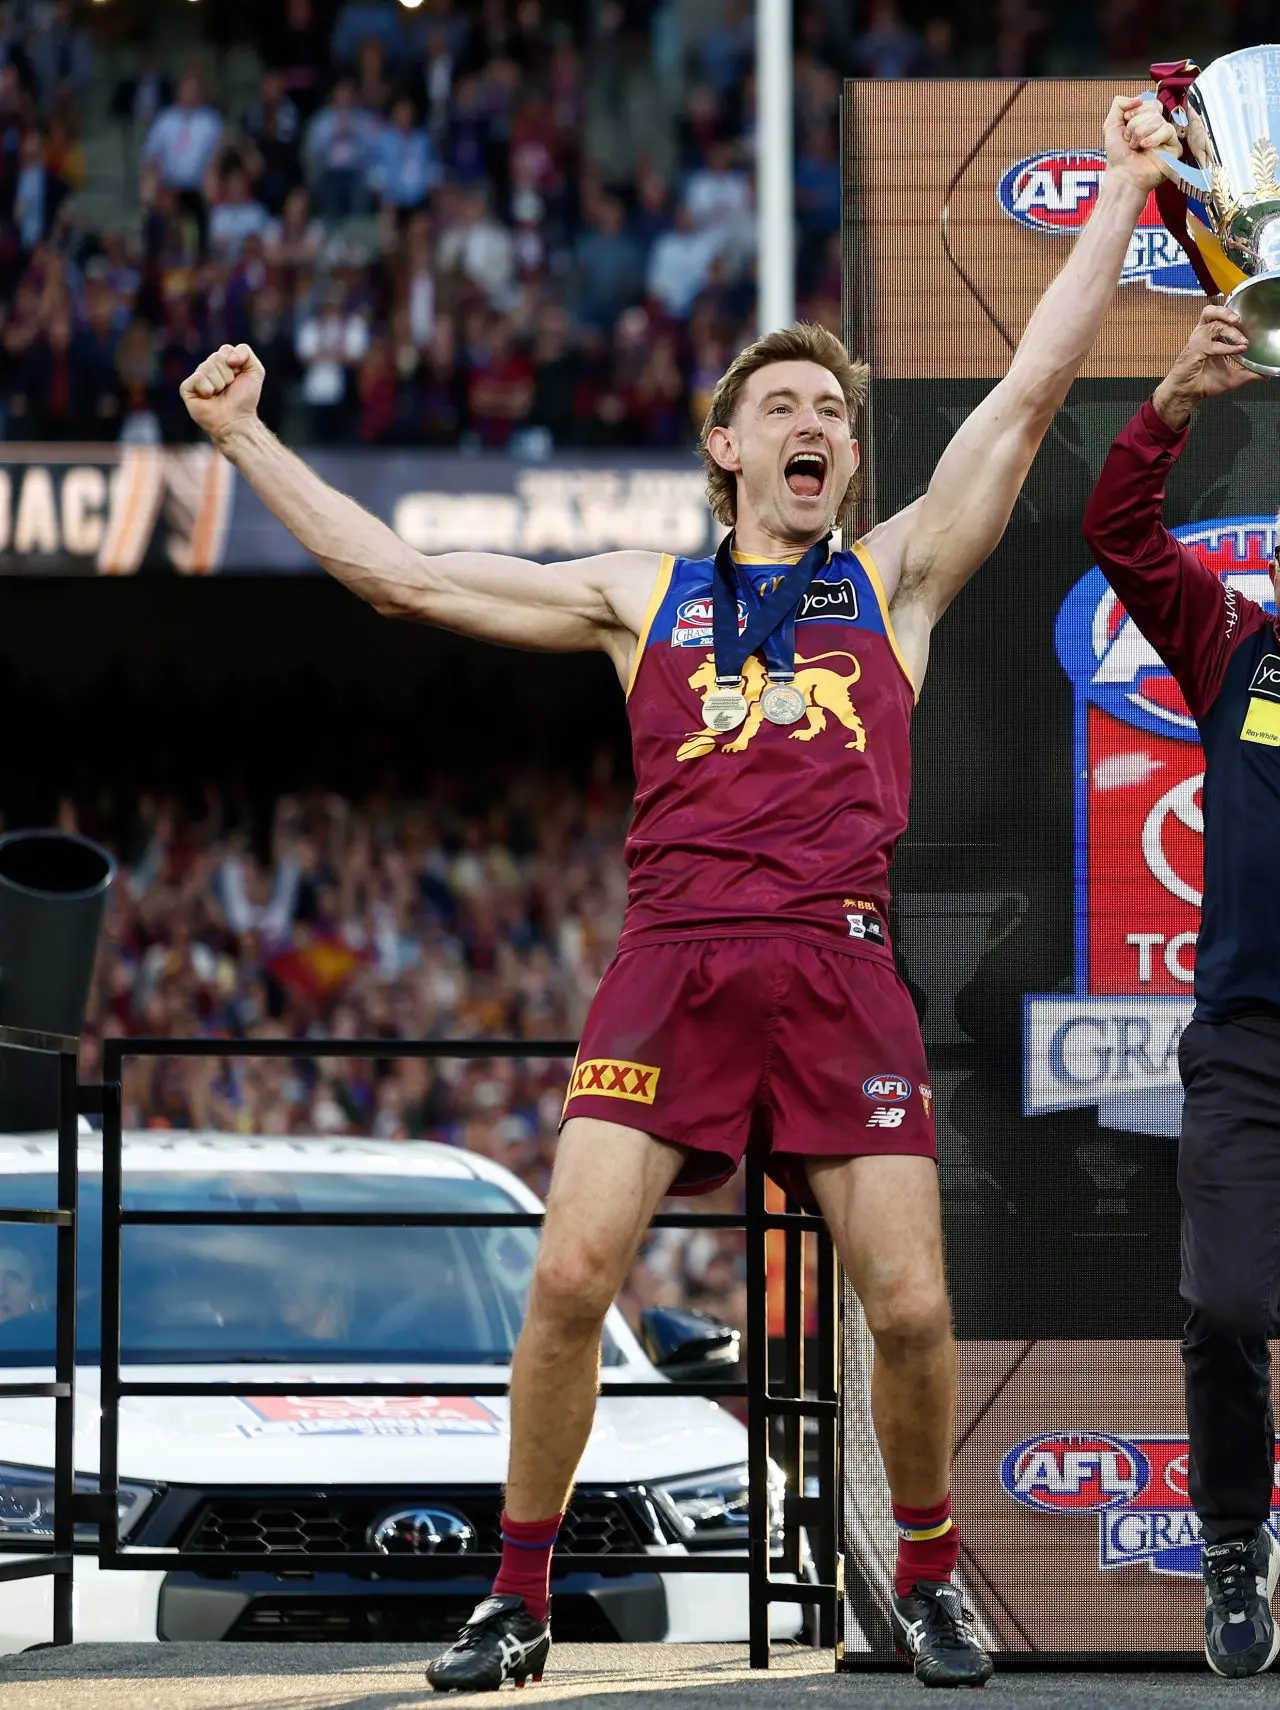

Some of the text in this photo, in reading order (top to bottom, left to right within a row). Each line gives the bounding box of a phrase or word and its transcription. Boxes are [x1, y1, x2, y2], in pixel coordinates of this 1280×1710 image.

[1013, 169, 1104, 210] AF
[801, 586, 849, 615] youi
[574, 1064, 654, 1097] XXXX
[868, 1080, 908, 1096] AFL
[1014, 1451, 1139, 1492] AFL
[1111, 1513, 1206, 1554] GRA
